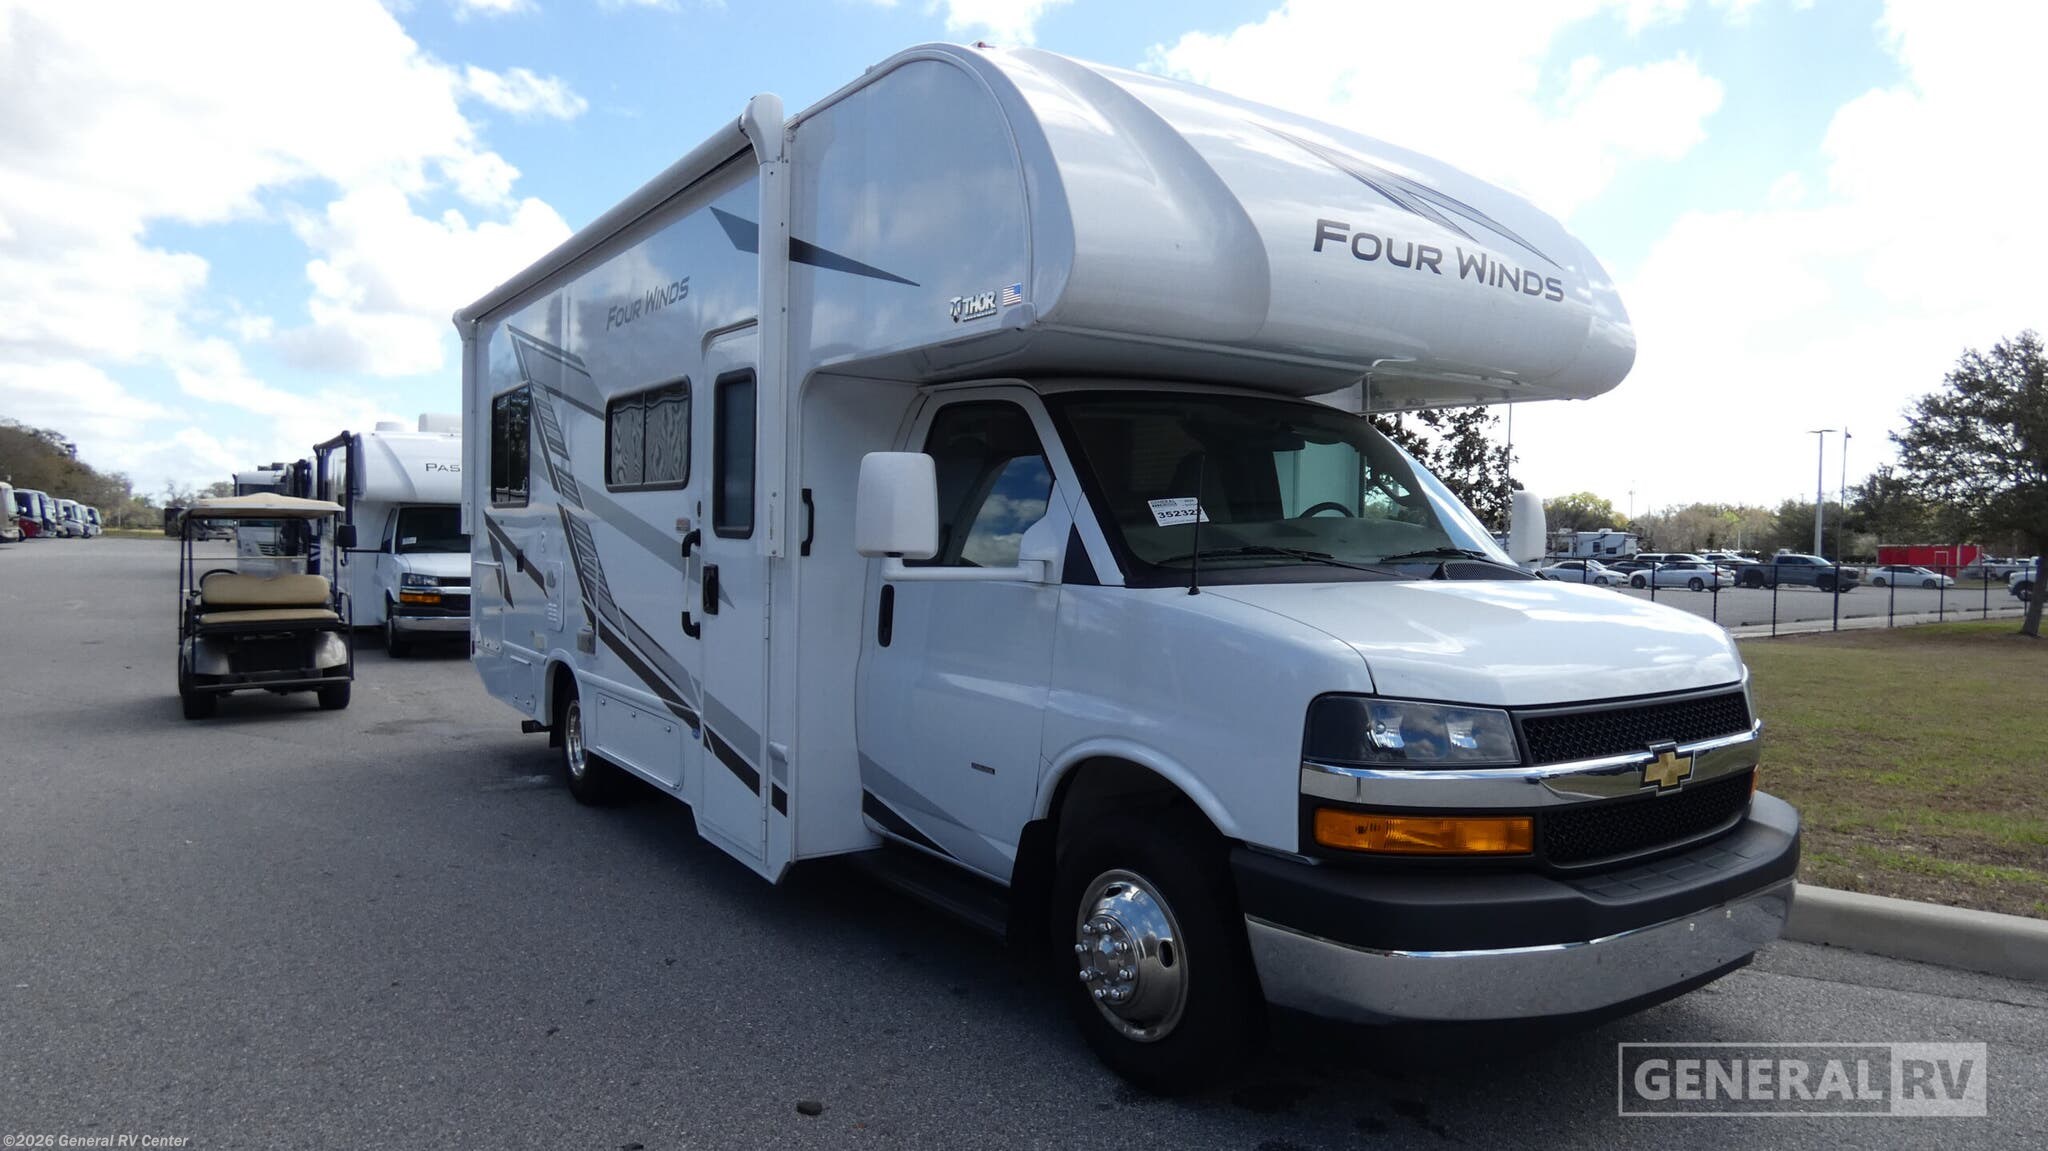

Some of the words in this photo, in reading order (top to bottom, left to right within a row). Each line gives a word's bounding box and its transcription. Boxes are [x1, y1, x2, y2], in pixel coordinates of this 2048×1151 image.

[1313, 219, 1442, 275] FOUR
[1456, 246, 1564, 302] WINDS
[606, 298, 642, 332] FOUR
[645, 275, 690, 315] WINDS
[962, 291, 997, 316] THOR
